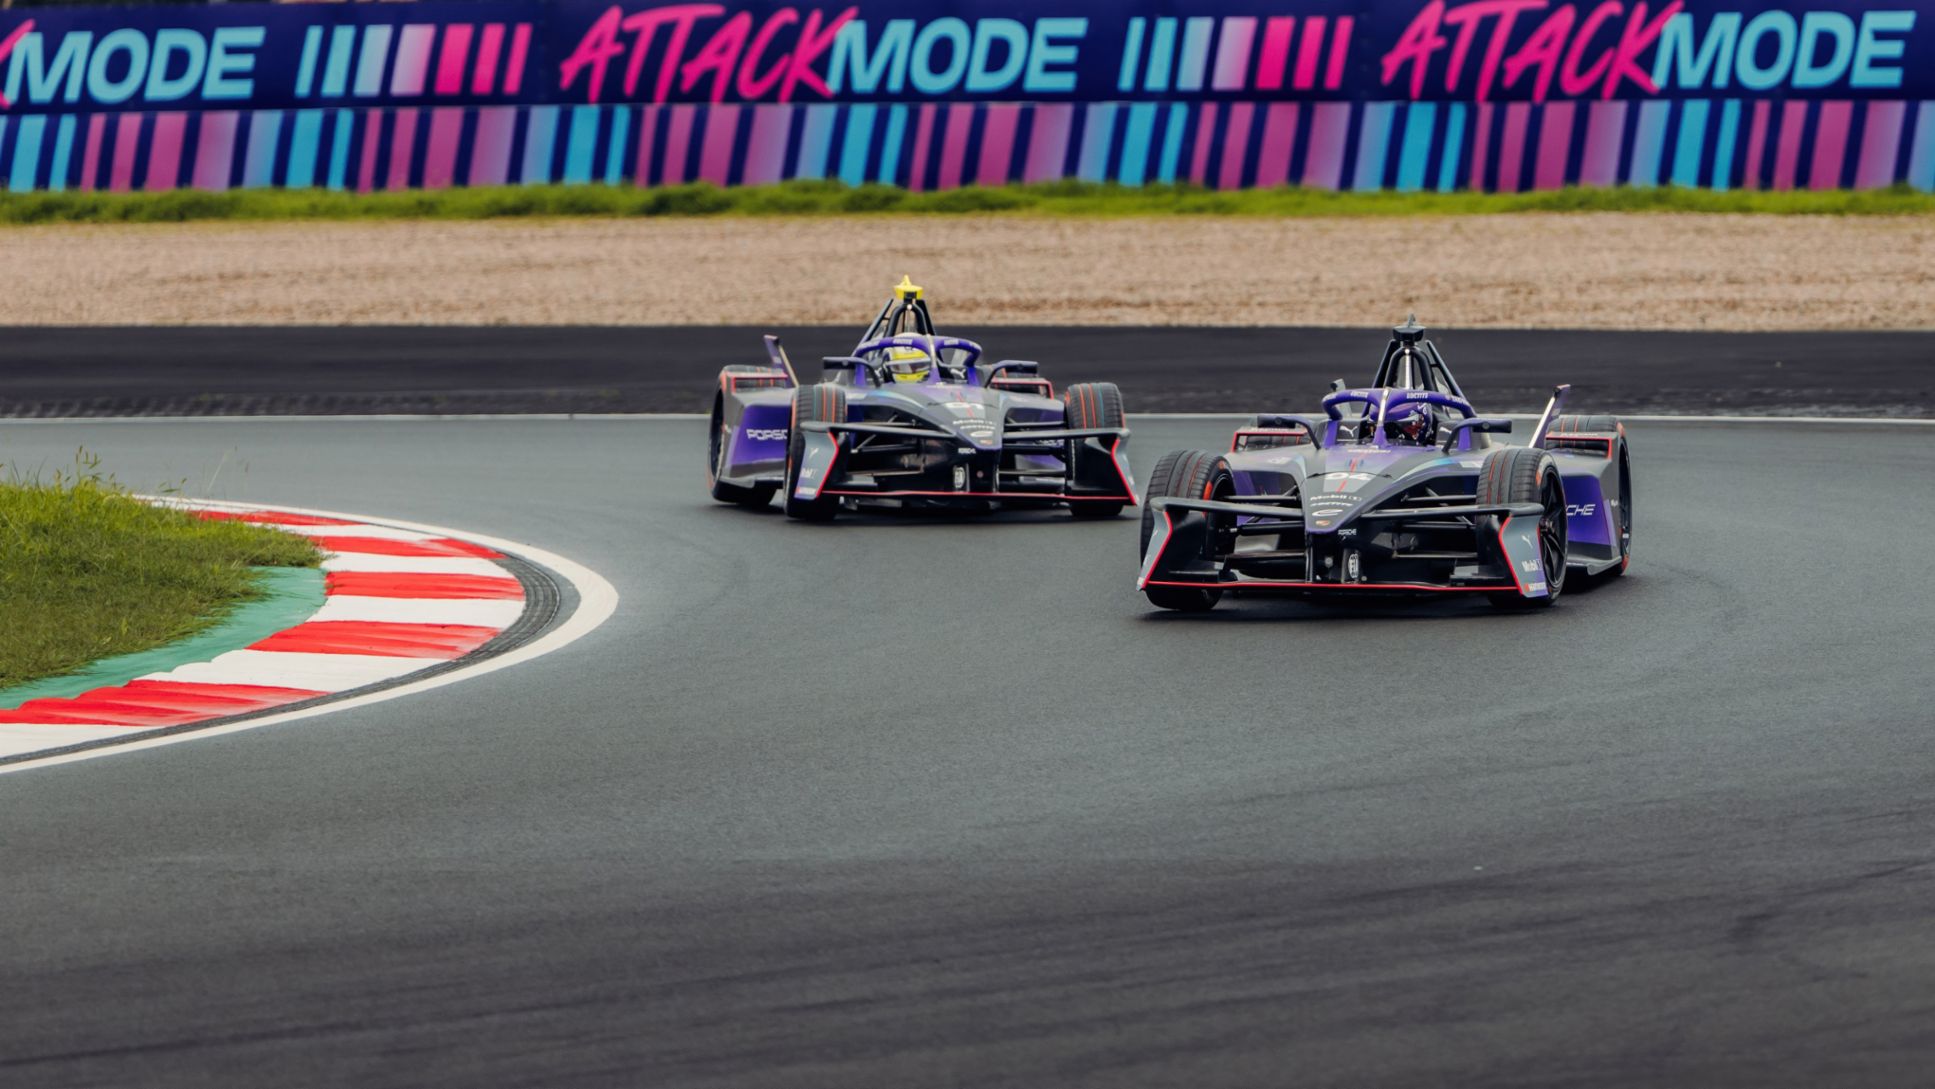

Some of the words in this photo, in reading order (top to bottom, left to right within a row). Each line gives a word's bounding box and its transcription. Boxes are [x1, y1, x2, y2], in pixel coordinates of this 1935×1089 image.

[4, 26, 266, 104] MODE
[560, 4, 858, 104] ATTACK
[827, 17, 1087, 93] MODE
[1382, 0, 1683, 102] ATTACK
[1651, 10, 1915, 89] MODE
